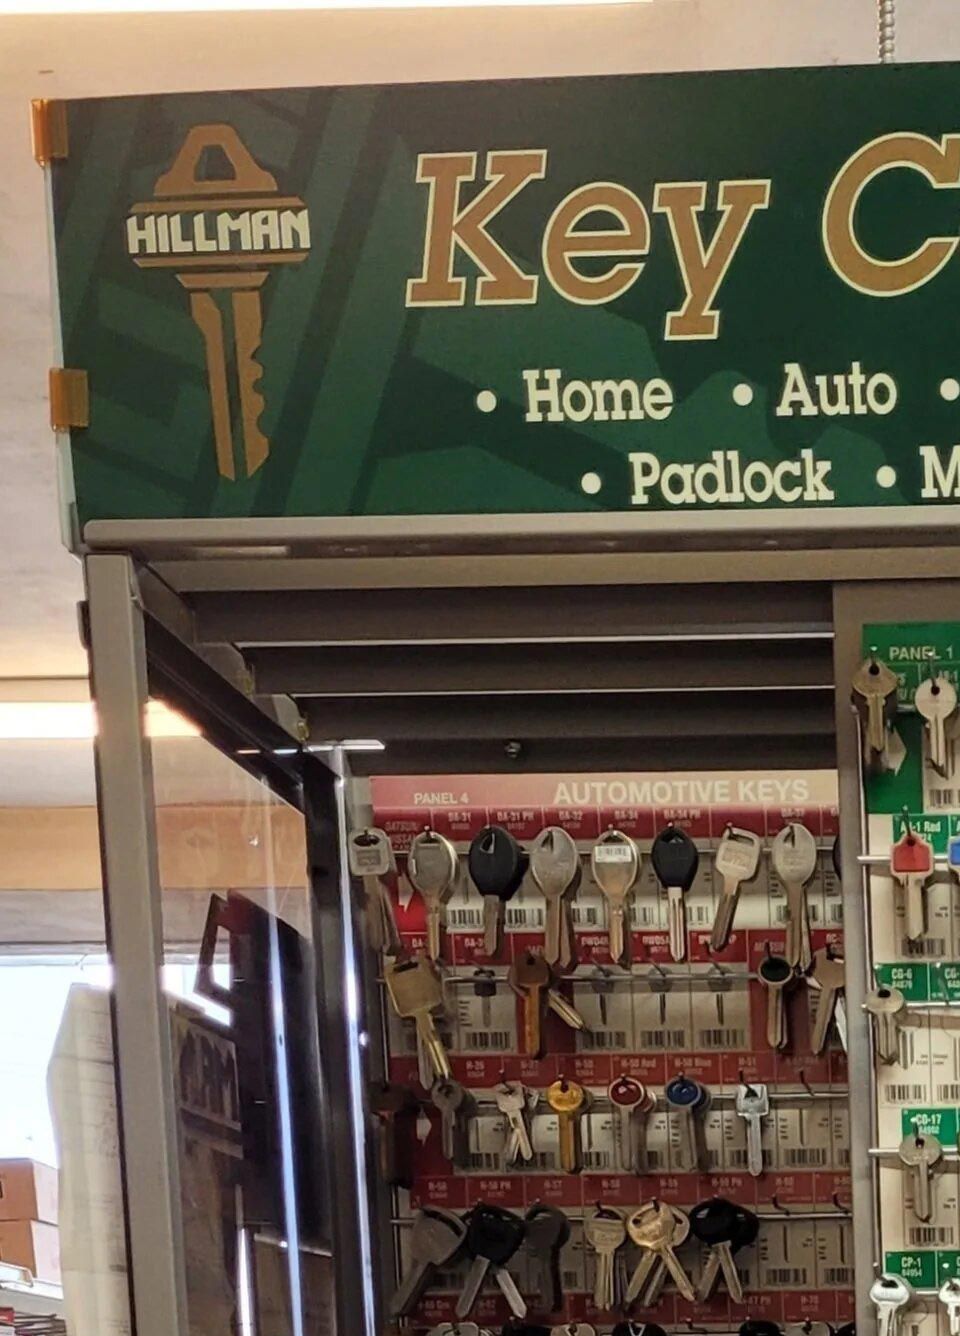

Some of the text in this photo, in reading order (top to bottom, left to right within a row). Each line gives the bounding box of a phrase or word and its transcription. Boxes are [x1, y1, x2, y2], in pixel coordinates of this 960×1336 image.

[126, 207, 311, 254] HILLMAN
[405, 149, 772, 341] Key
[525, 370, 673, 422] Home
[776, 363, 897, 417] Auto
[630, 449, 834, 504] Padlock
[889, 648, 941, 660] PANEL
[414, 792, 469, 805] PANEL 4
[554, 778, 810, 805] AUTOMOTIVE KEYS
[901, 1257, 921, 1268] CP-1
